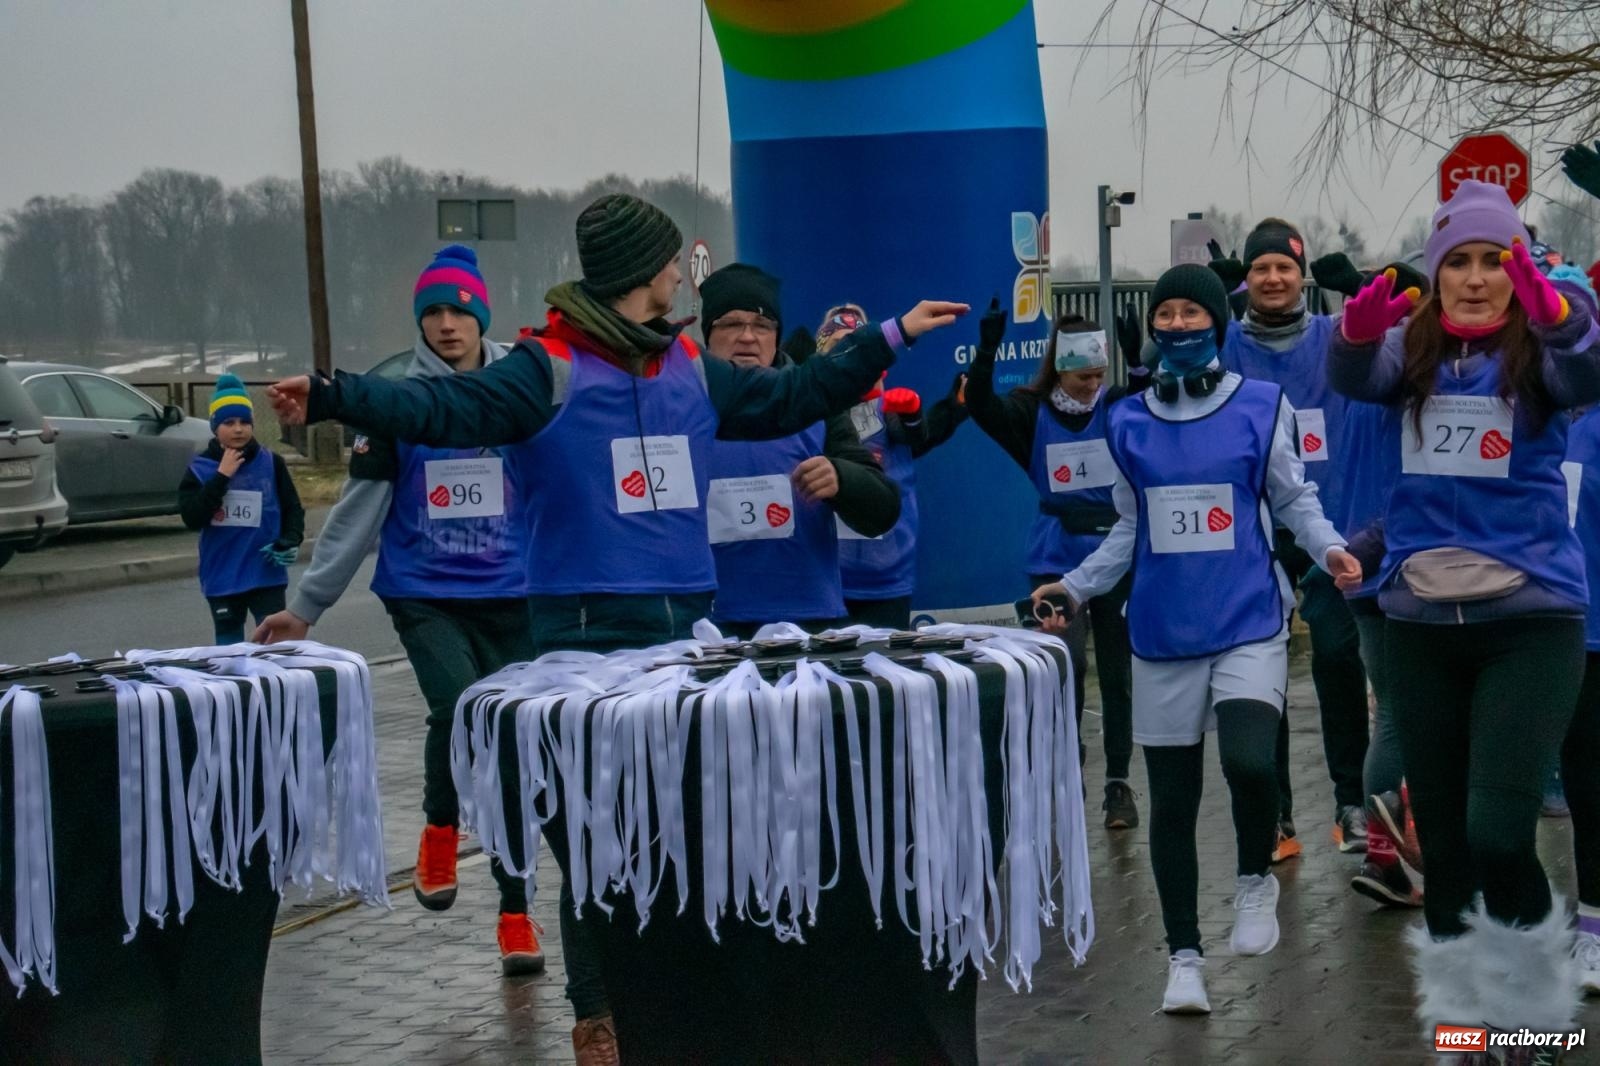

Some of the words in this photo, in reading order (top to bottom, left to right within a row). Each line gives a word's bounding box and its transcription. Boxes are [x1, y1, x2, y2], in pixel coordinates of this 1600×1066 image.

[1449, 163, 1521, 194] STOP
[955, 341, 1017, 365] GNA
[1433, 424, 1476, 454] 27
[652, 466, 668, 493] 2
[1075, 461, 1088, 479] 4
[452, 483, 482, 506] 96
[225, 505, 252, 520] 146
[740, 501, 756, 525] 3
[1171, 510, 1204, 535] 31
